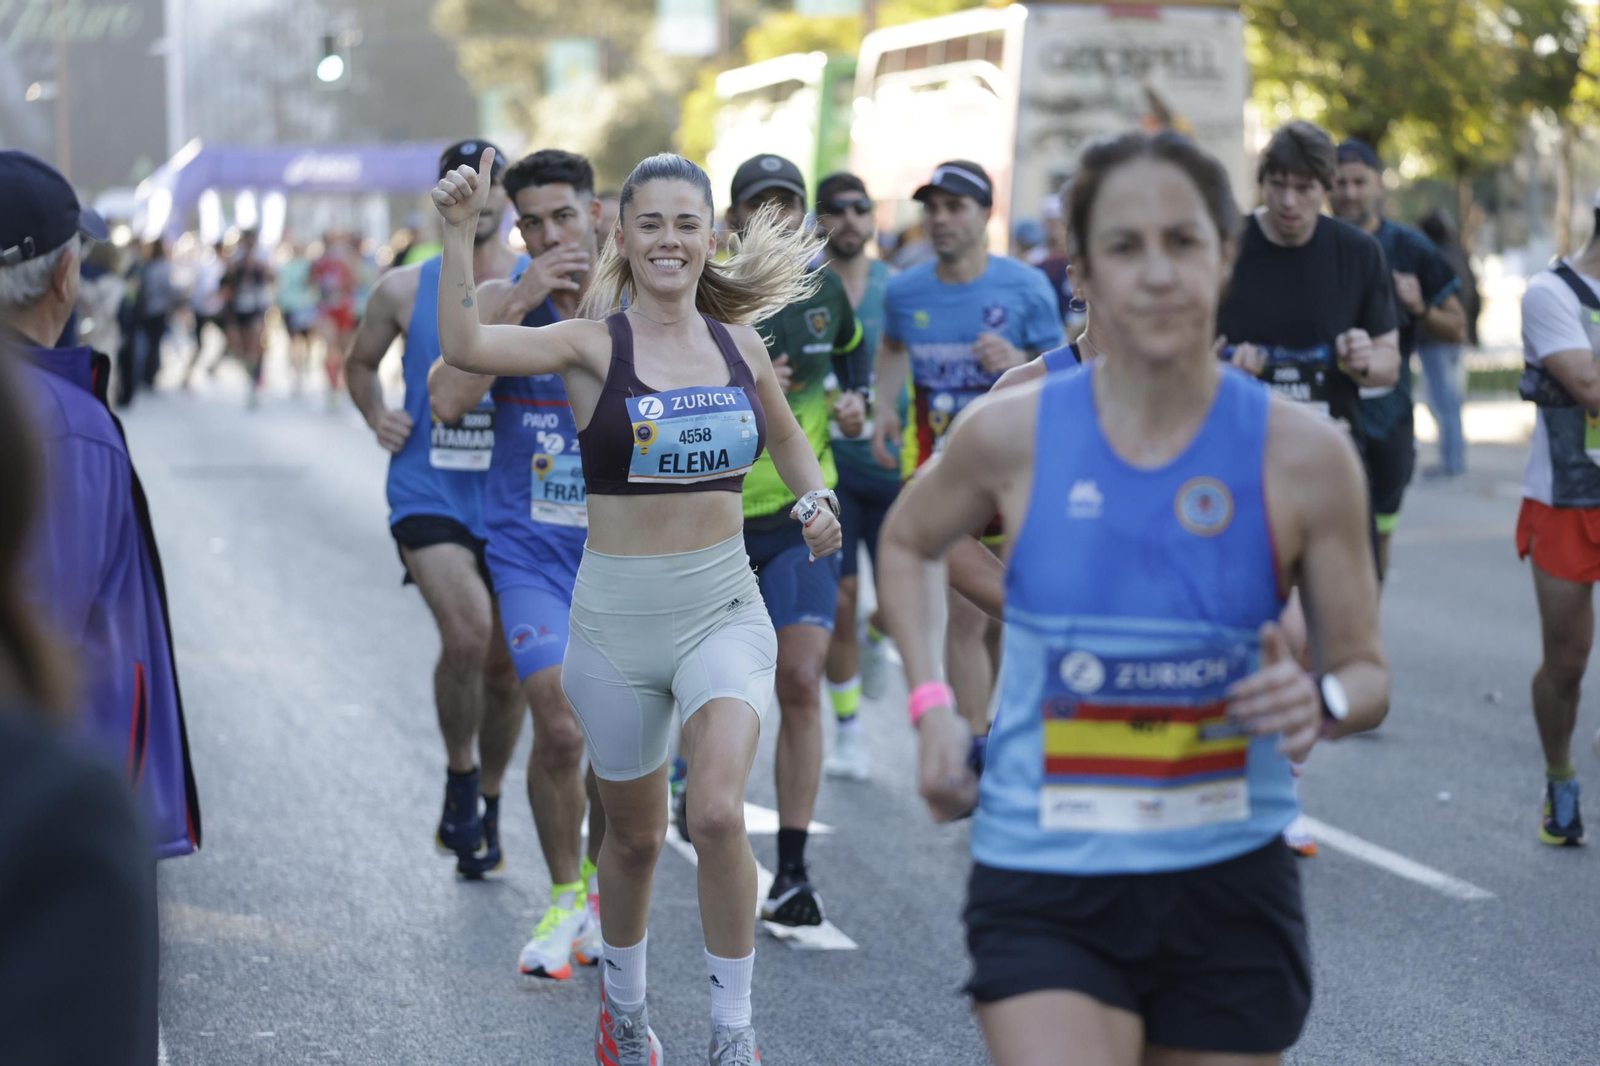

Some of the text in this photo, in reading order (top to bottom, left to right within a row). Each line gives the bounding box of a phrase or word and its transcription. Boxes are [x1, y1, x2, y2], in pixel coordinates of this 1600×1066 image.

[671, 393, 736, 410] ZURICH
[522, 412, 559, 429] PAVO
[679, 428, 712, 444] 4558
[658, 449, 730, 473] ELENA
[1113, 656, 1229, 690] ZURICH
